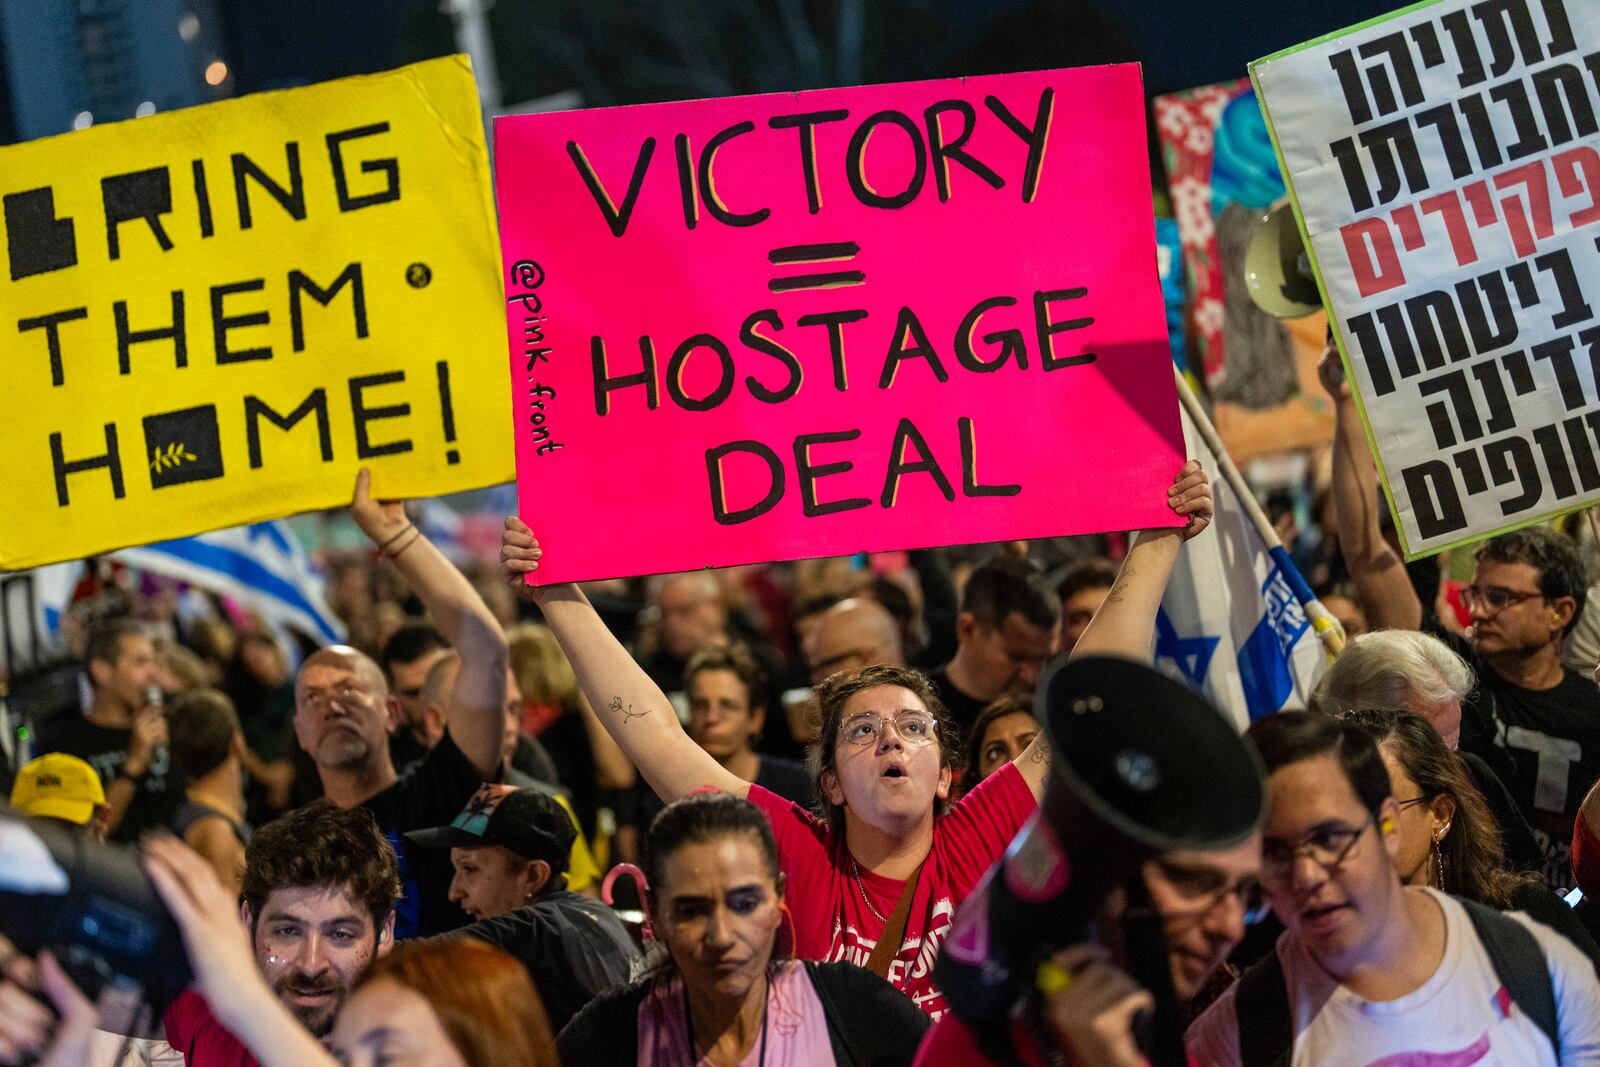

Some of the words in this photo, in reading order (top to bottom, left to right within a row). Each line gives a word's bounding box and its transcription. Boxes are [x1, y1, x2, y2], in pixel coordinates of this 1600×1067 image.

[1328, 0, 1577, 126] נתניהו
[3, 122, 401, 281] BRING
[566, 87, 1056, 238] VICTORY
[17, 263, 369, 387] THEM
[508, 260, 564, 457] @pink.front
[592, 288, 1098, 417] HOSTAGE
[1346, 247, 1594, 397] ביטחון
[706, 417, 1022, 525] DEAL
